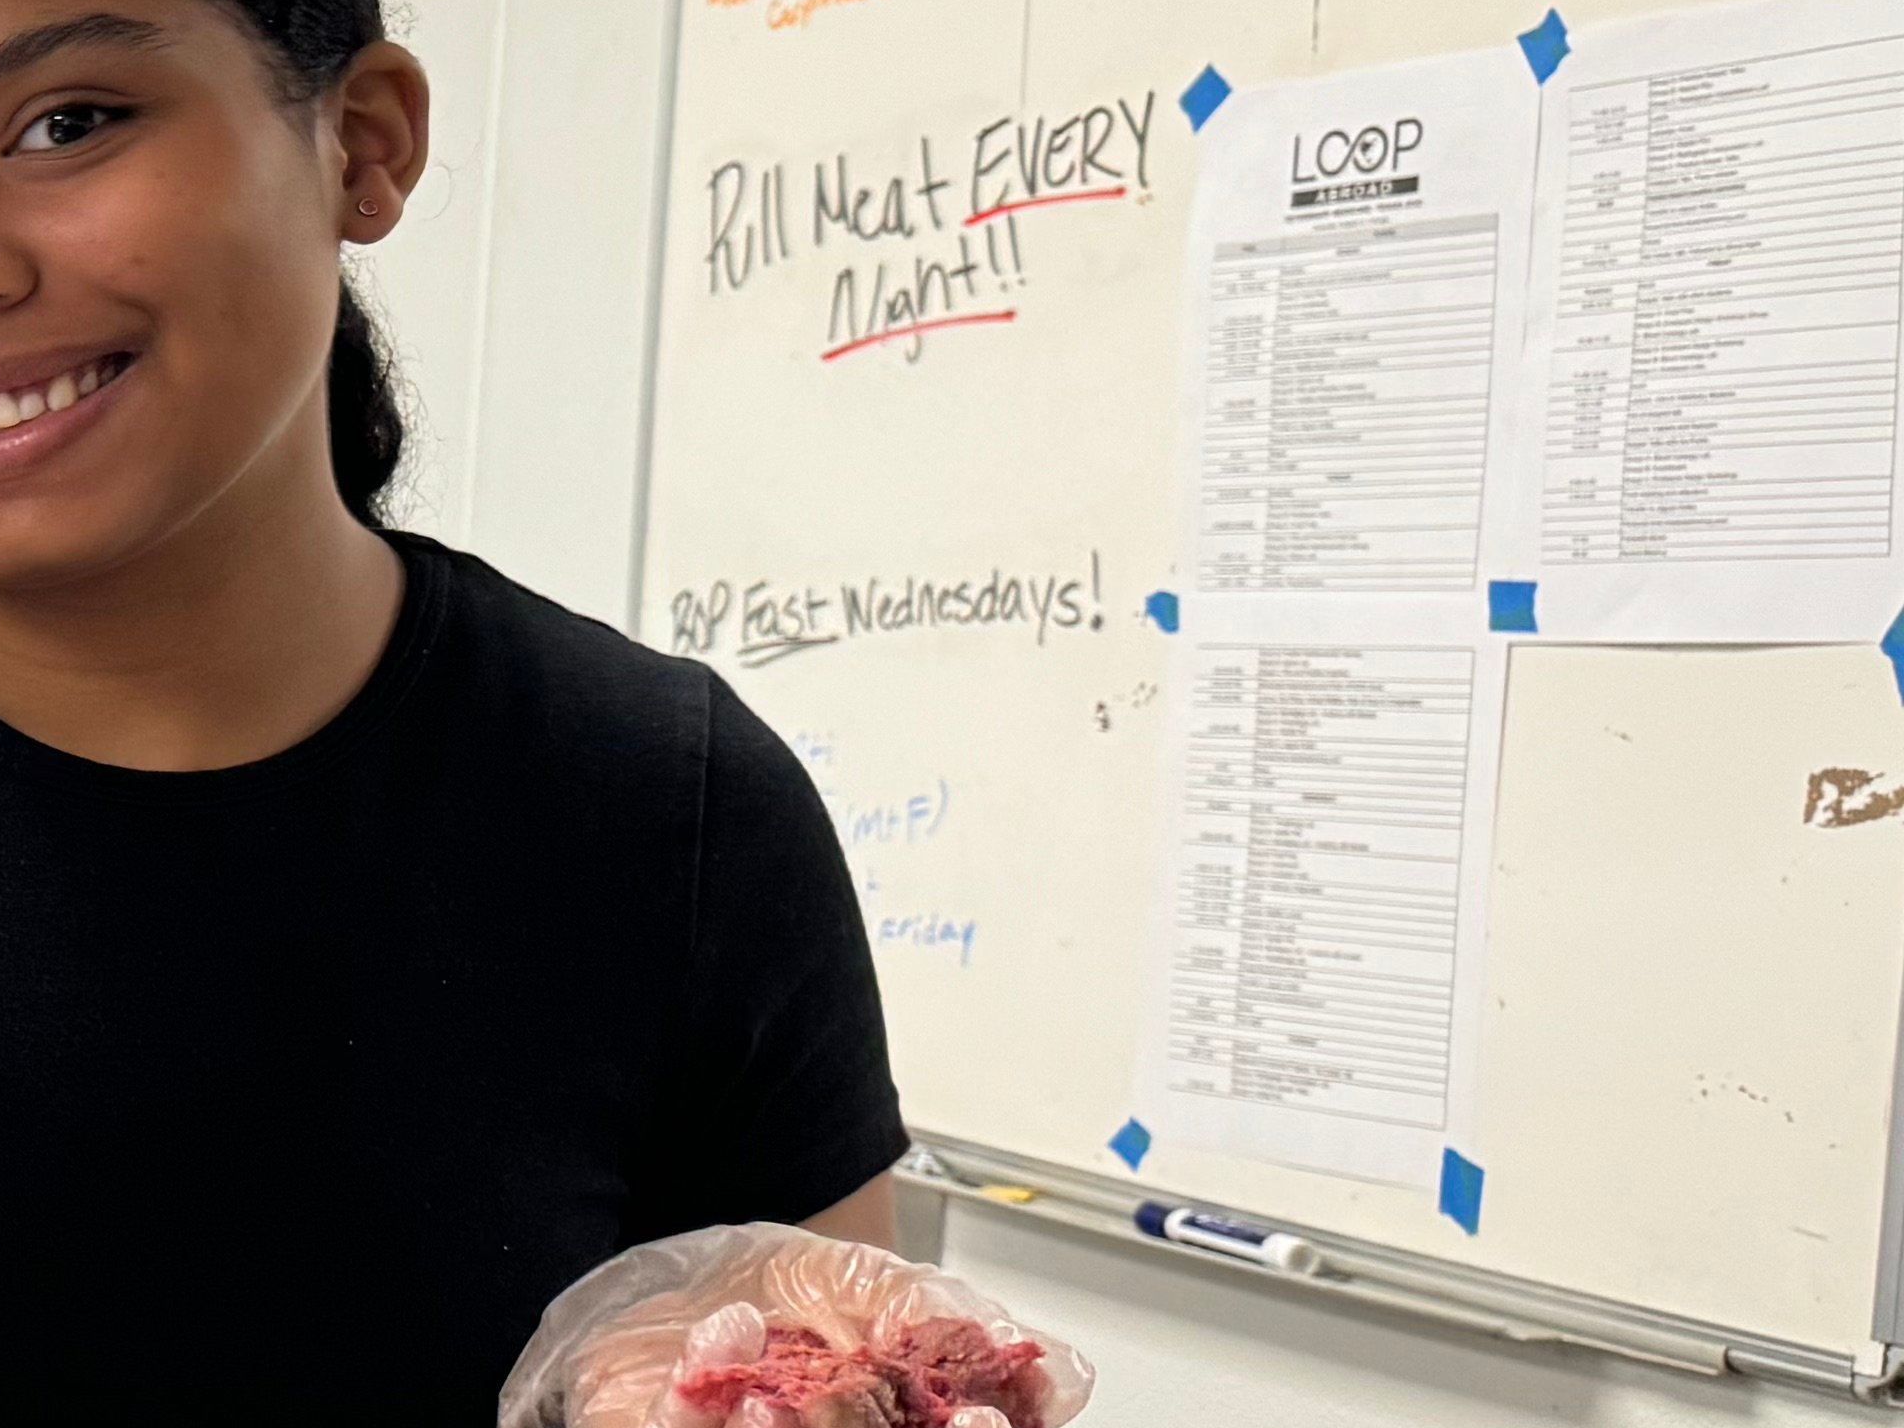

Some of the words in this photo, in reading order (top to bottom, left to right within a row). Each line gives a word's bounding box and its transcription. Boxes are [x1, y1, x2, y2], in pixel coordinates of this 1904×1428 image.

[705, 159, 790, 295] Pull
[813, 135, 950, 246] Meat
[970, 90, 1156, 217] EVERY
[1292, 117, 1424, 184] LOOP
[741, 580, 829, 644] Fast
[840, 548, 1105, 648] Wednesdays!
